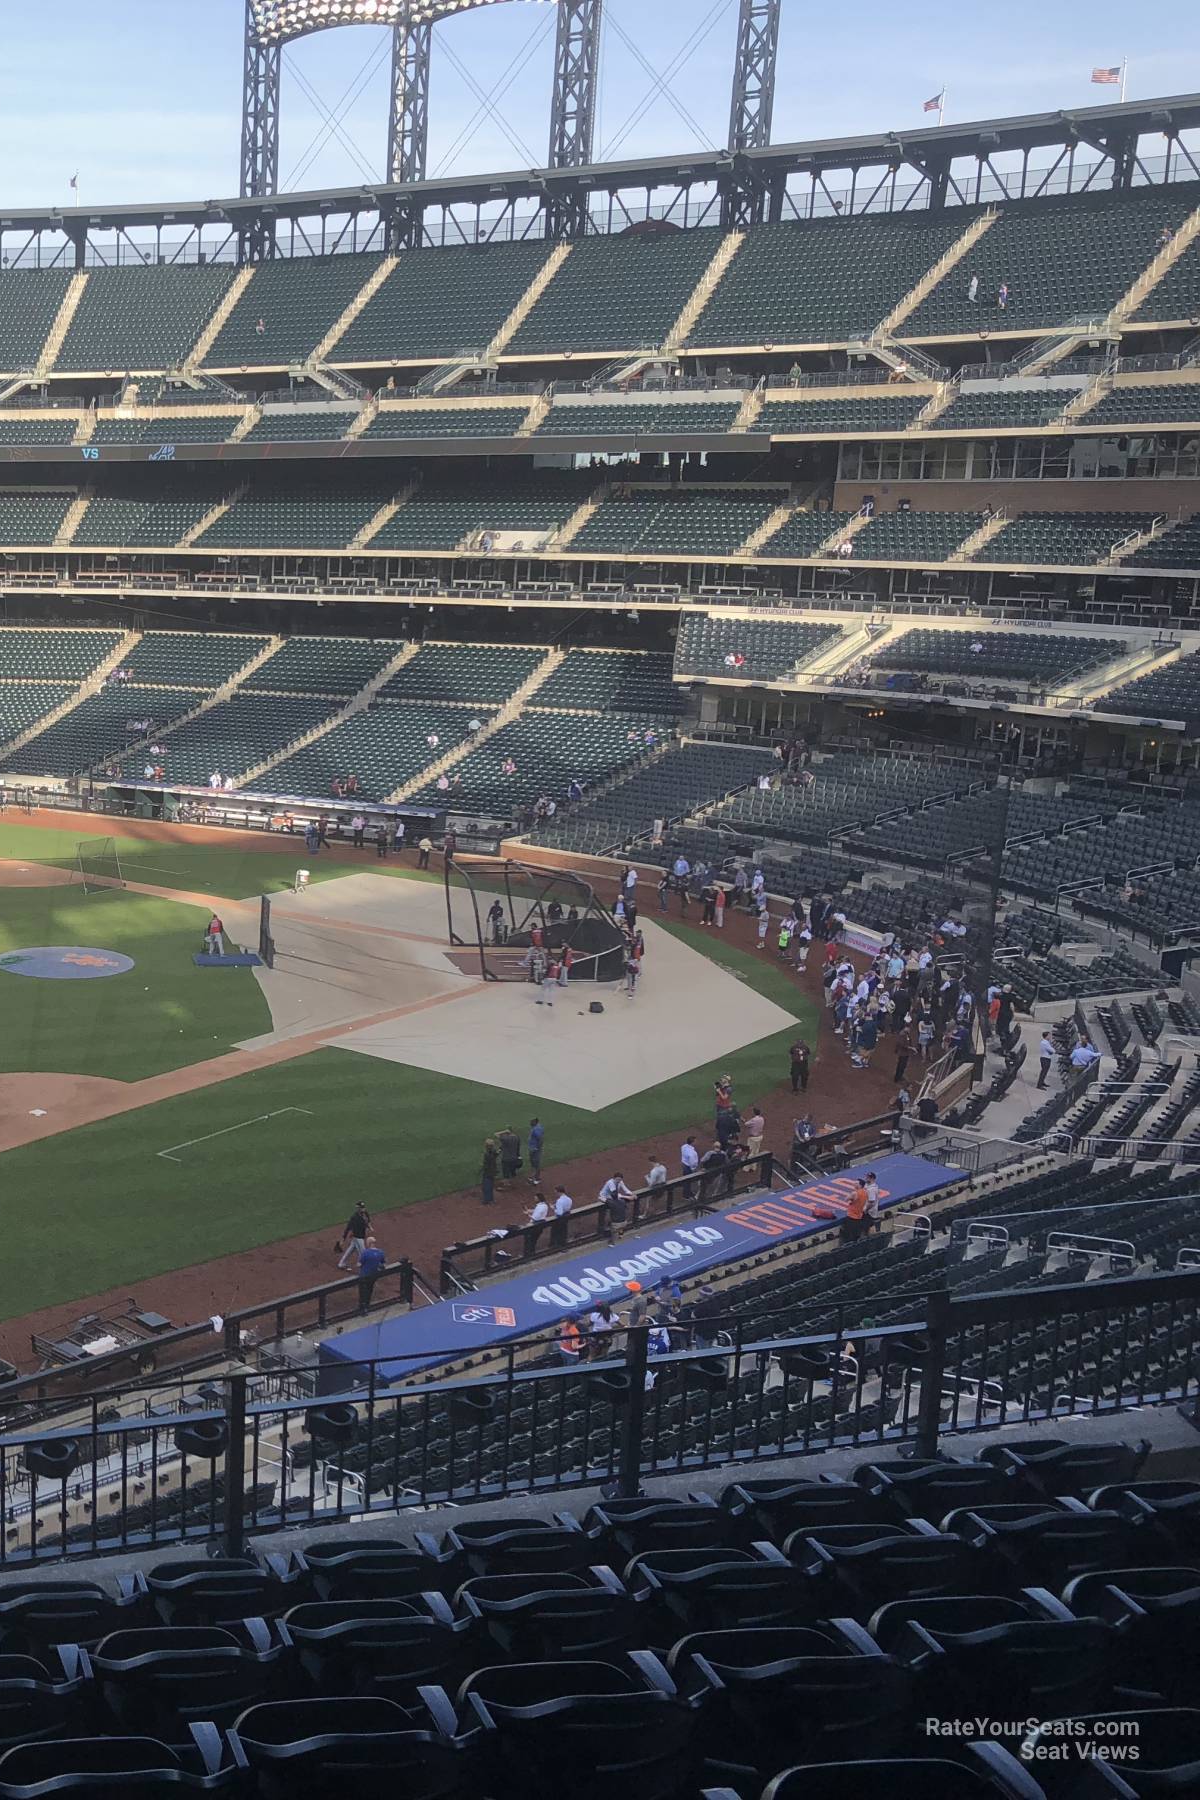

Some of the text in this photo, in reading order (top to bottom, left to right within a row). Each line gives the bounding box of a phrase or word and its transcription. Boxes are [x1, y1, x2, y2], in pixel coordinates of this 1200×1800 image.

[82, 448, 99, 459] VS
[532, 1240, 693, 1309] Welcome
[674, 1226, 725, 1247] to
[724, 1201, 817, 1236] CITI
[461, 1308, 493, 1321] citi
